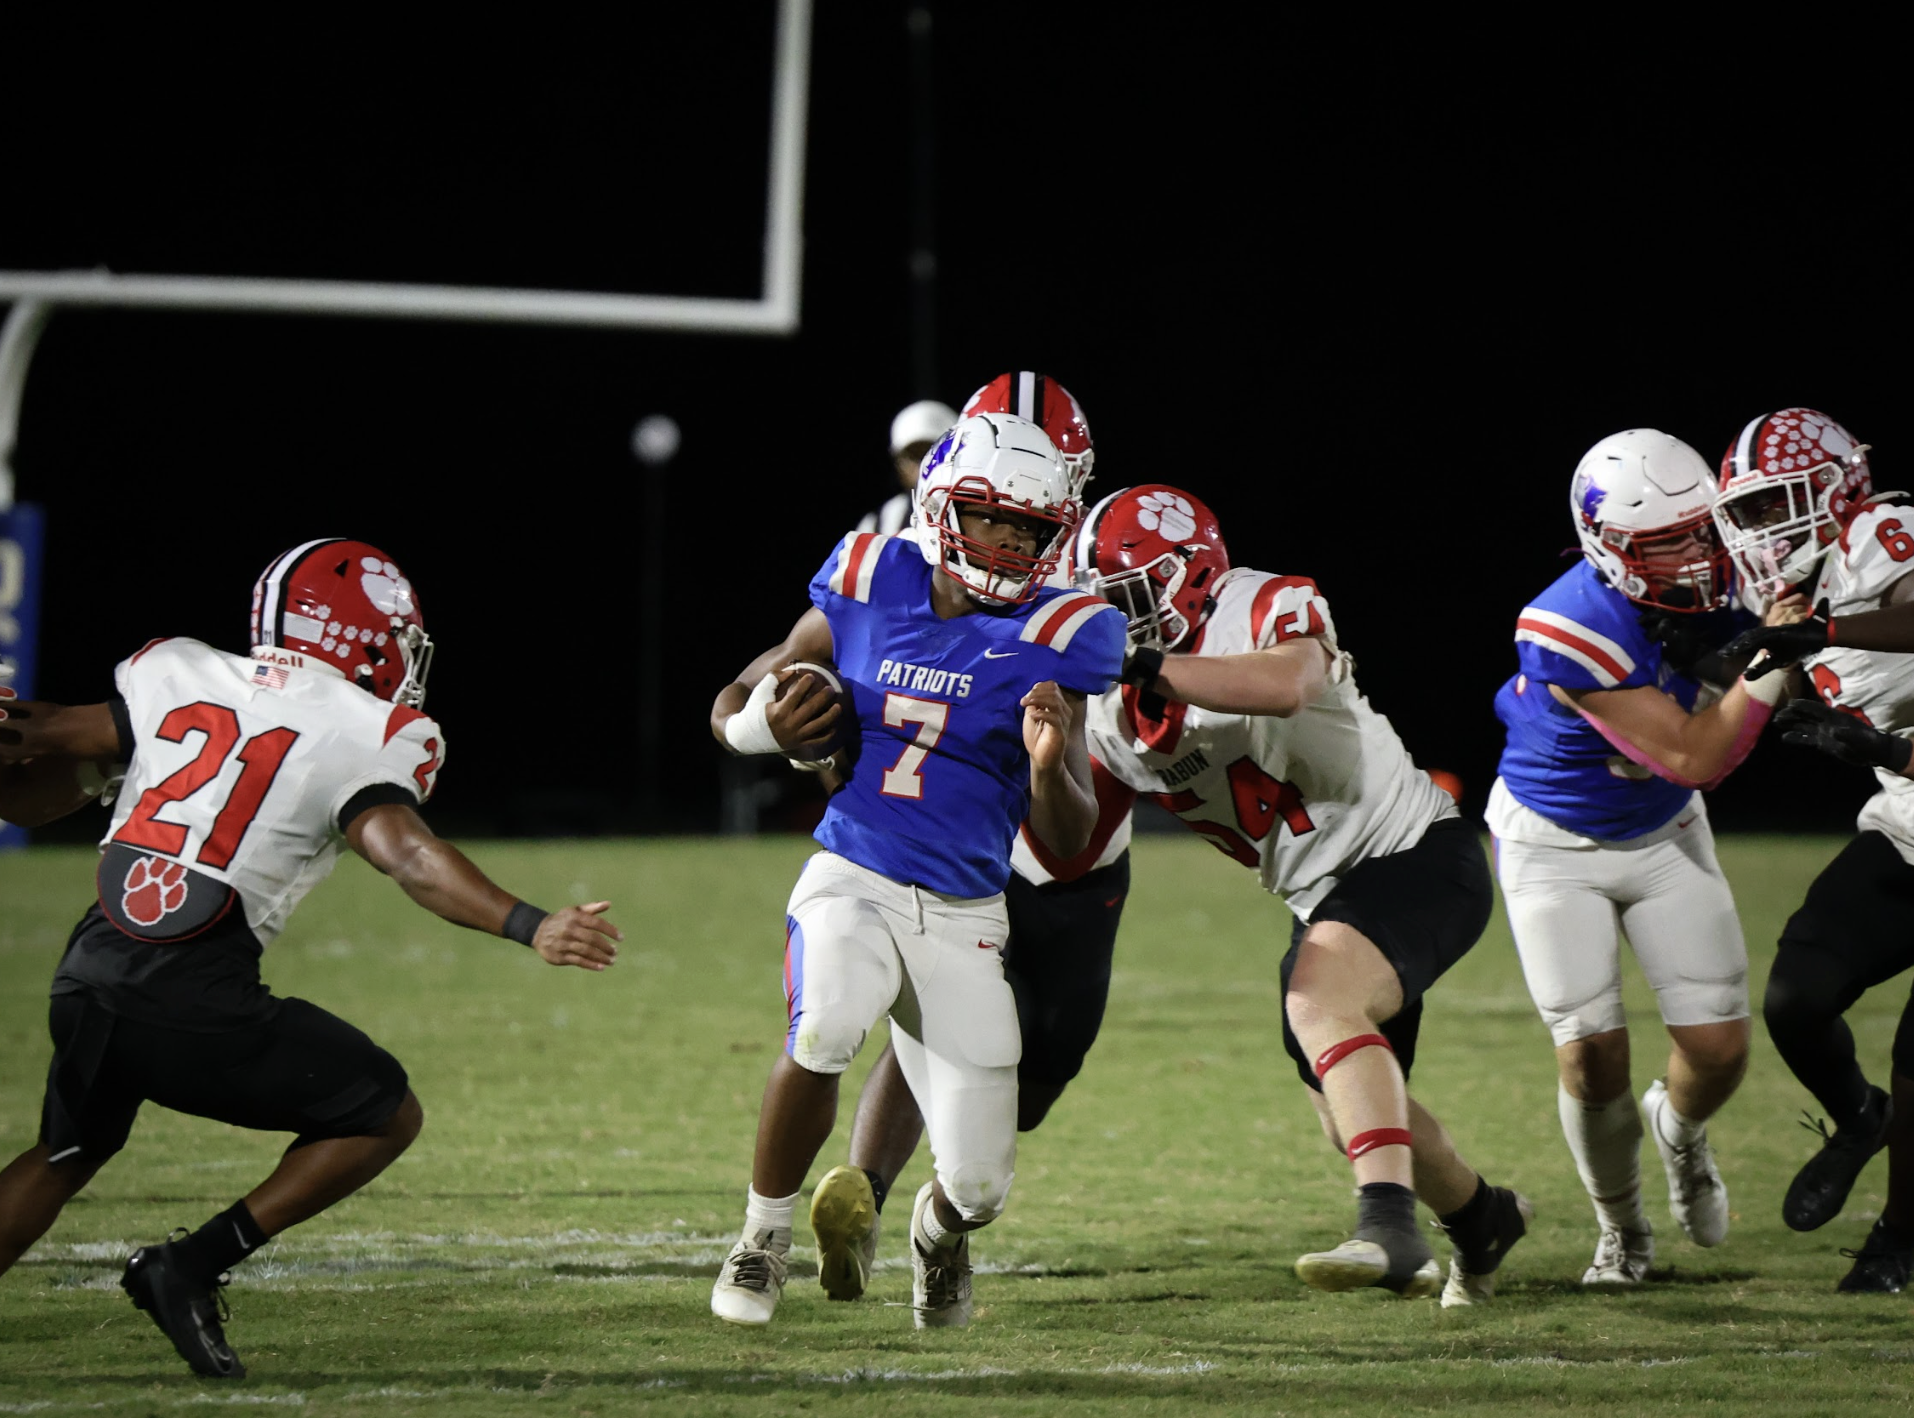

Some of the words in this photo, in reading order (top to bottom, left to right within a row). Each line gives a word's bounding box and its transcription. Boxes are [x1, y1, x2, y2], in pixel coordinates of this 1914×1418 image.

[1875, 518, 1914, 562] 6
[876, 659, 973, 698] PATRIOTS
[878, 690, 951, 800] 7
[111, 700, 300, 871] 21
